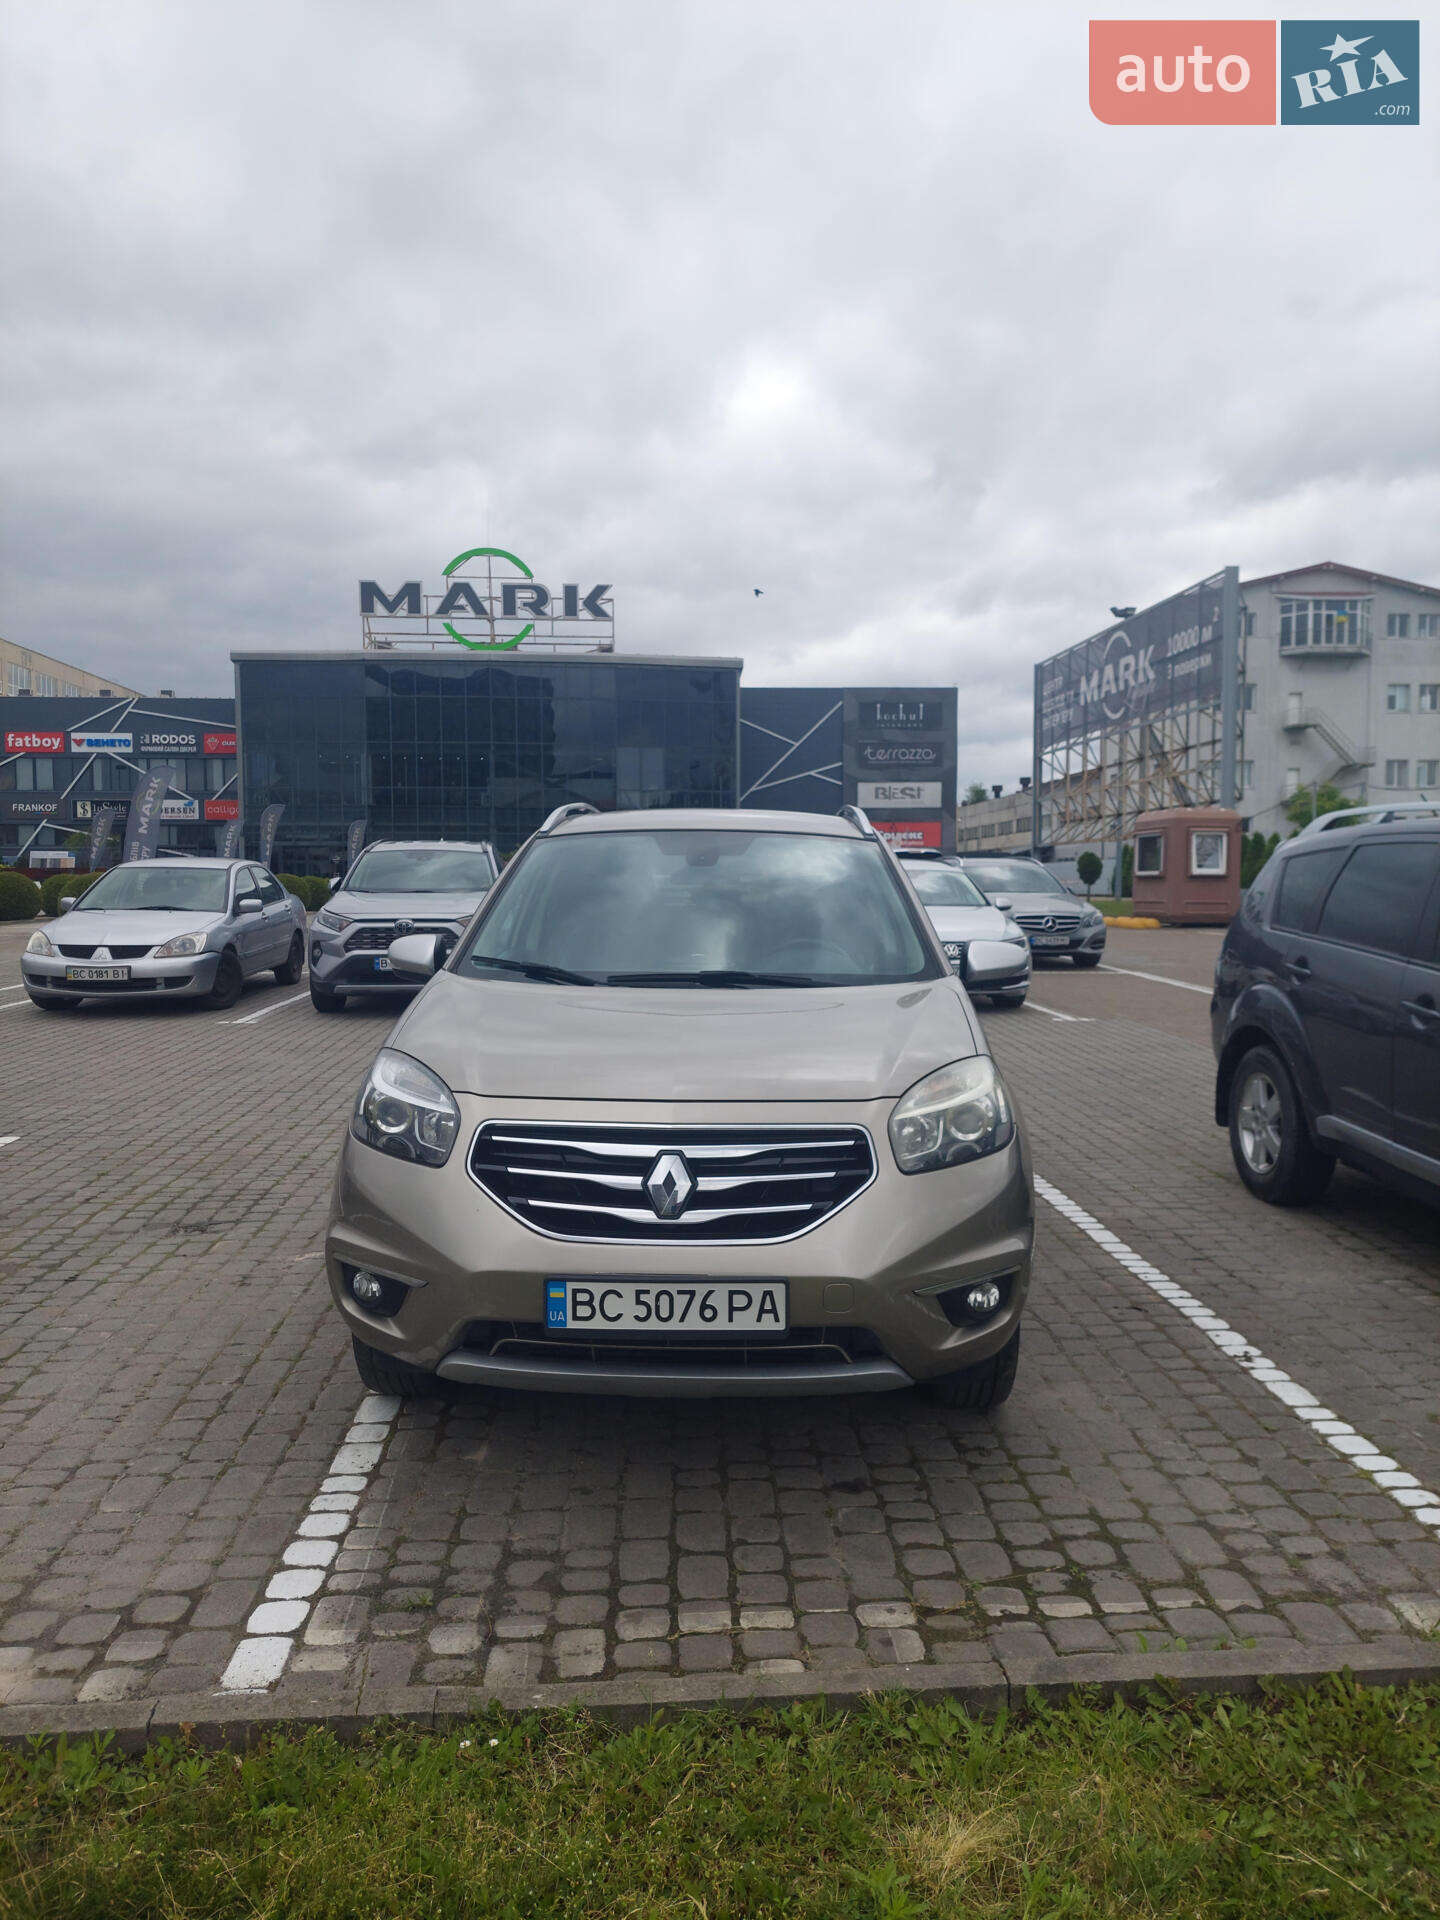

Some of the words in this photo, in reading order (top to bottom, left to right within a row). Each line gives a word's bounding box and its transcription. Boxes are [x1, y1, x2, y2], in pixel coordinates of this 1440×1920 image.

[359, 579, 614, 621] MARK
[1079, 644, 1157, 706] MARK
[7, 733, 60, 749] fatboy
[151, 734, 196, 744] RODOS
[12, 803, 58, 812] FRANKOF
[138, 776, 161, 834] MARK
[88, 969, 109, 979] 0181
[571, 1288, 624, 1322] BC
[633, 1289, 719, 1323] 5076
[728, 1289, 781, 1323] PA
[550, 1311, 566, 1322] UA
